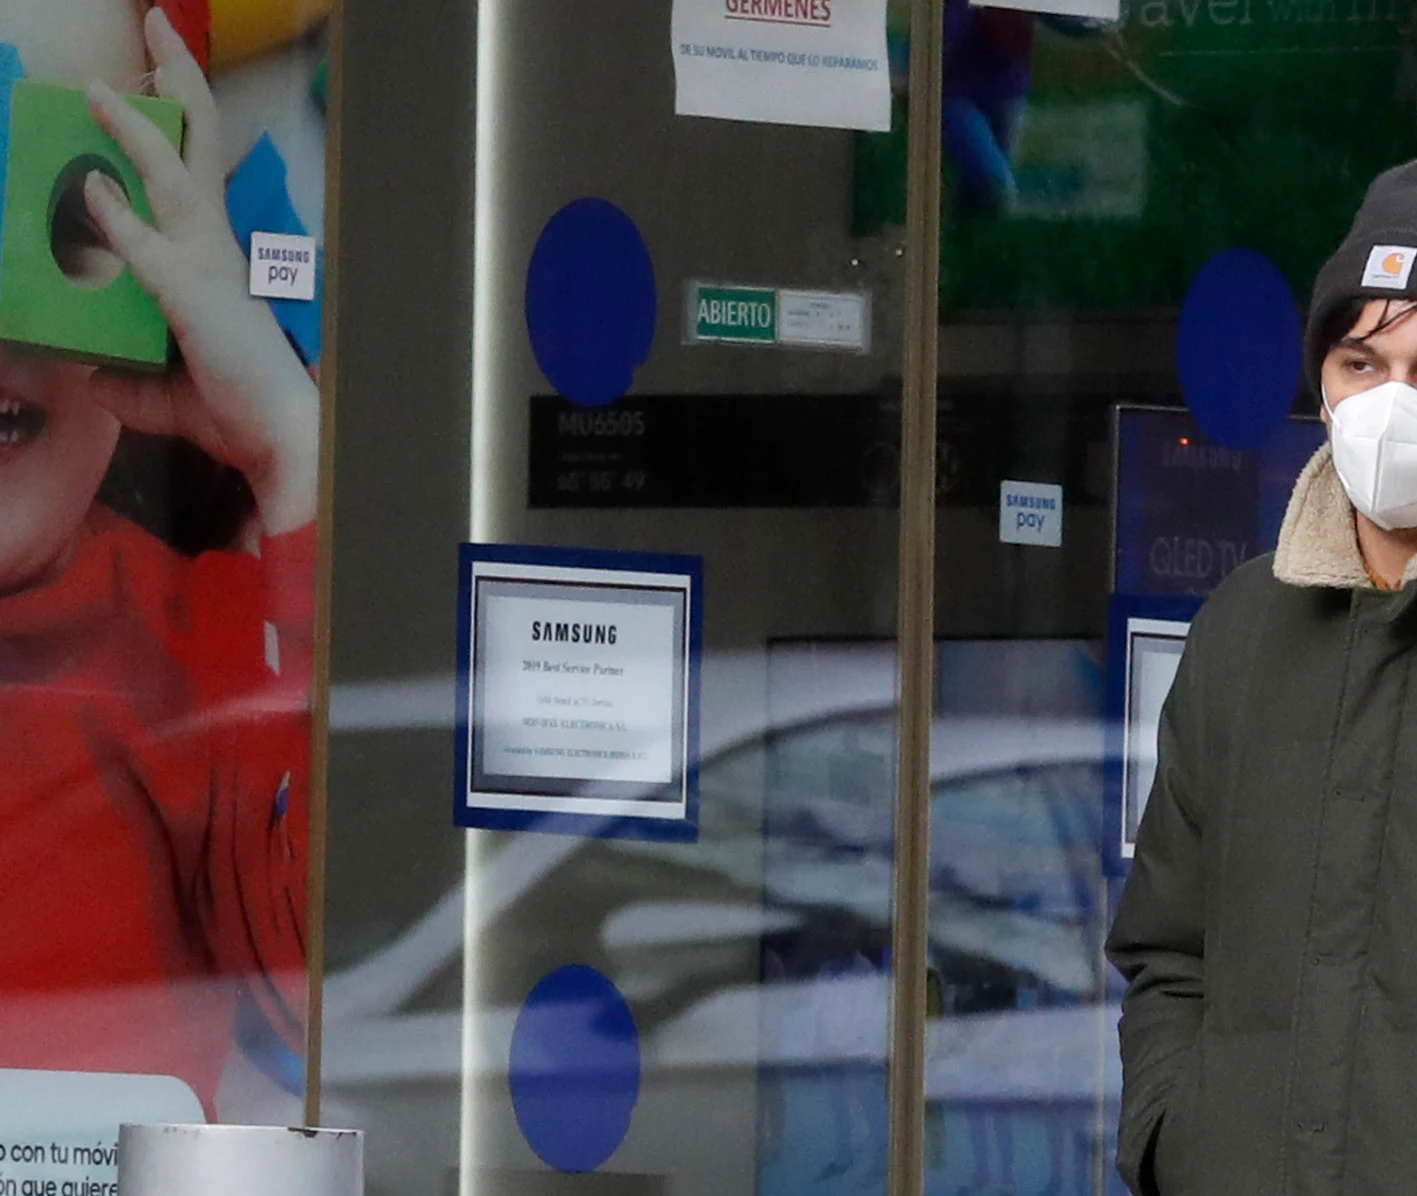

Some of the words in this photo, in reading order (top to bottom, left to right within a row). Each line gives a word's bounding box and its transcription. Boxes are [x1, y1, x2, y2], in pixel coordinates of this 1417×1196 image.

[258, 247, 311, 264] SAMSUNG
[268, 265, 299, 287] pay
[697, 298, 772, 329] ABIERTO
[1006, 493, 1057, 511] SAMSUNG
[1015, 511, 1046, 534] pay
[1149, 535, 1214, 578] QLED
[531, 619, 618, 646] SAMSUNG
[10, 1144, 45, 1163] con
[50, 1142, 69, 1165] tu
